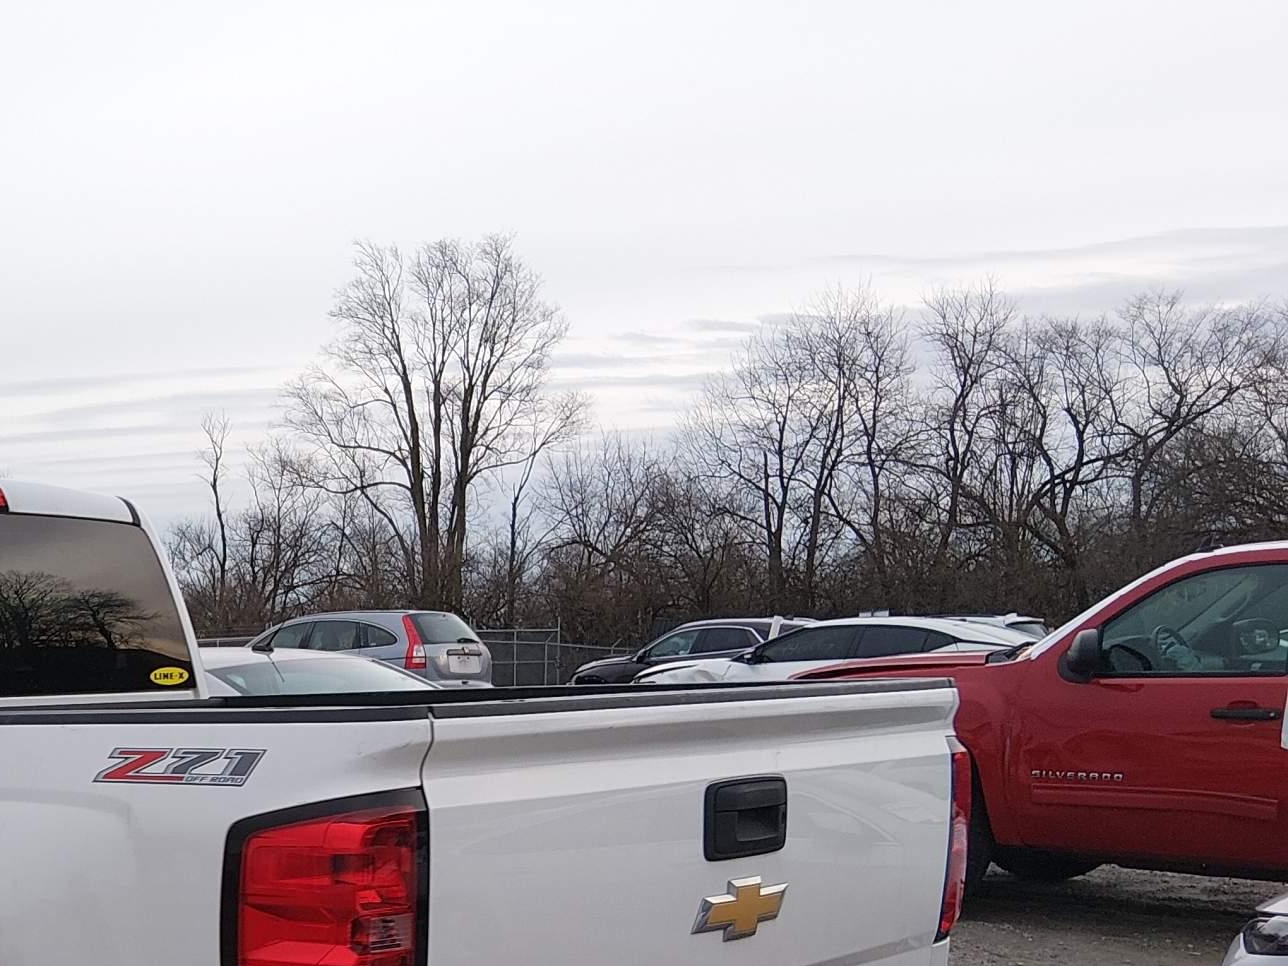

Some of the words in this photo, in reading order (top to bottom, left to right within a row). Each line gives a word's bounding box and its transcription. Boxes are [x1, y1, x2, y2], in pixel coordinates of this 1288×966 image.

[154, 671, 185, 681] LINE-X
[93, 748, 267, 787] Z71
[1031, 770, 1123, 781] SILVERADO
